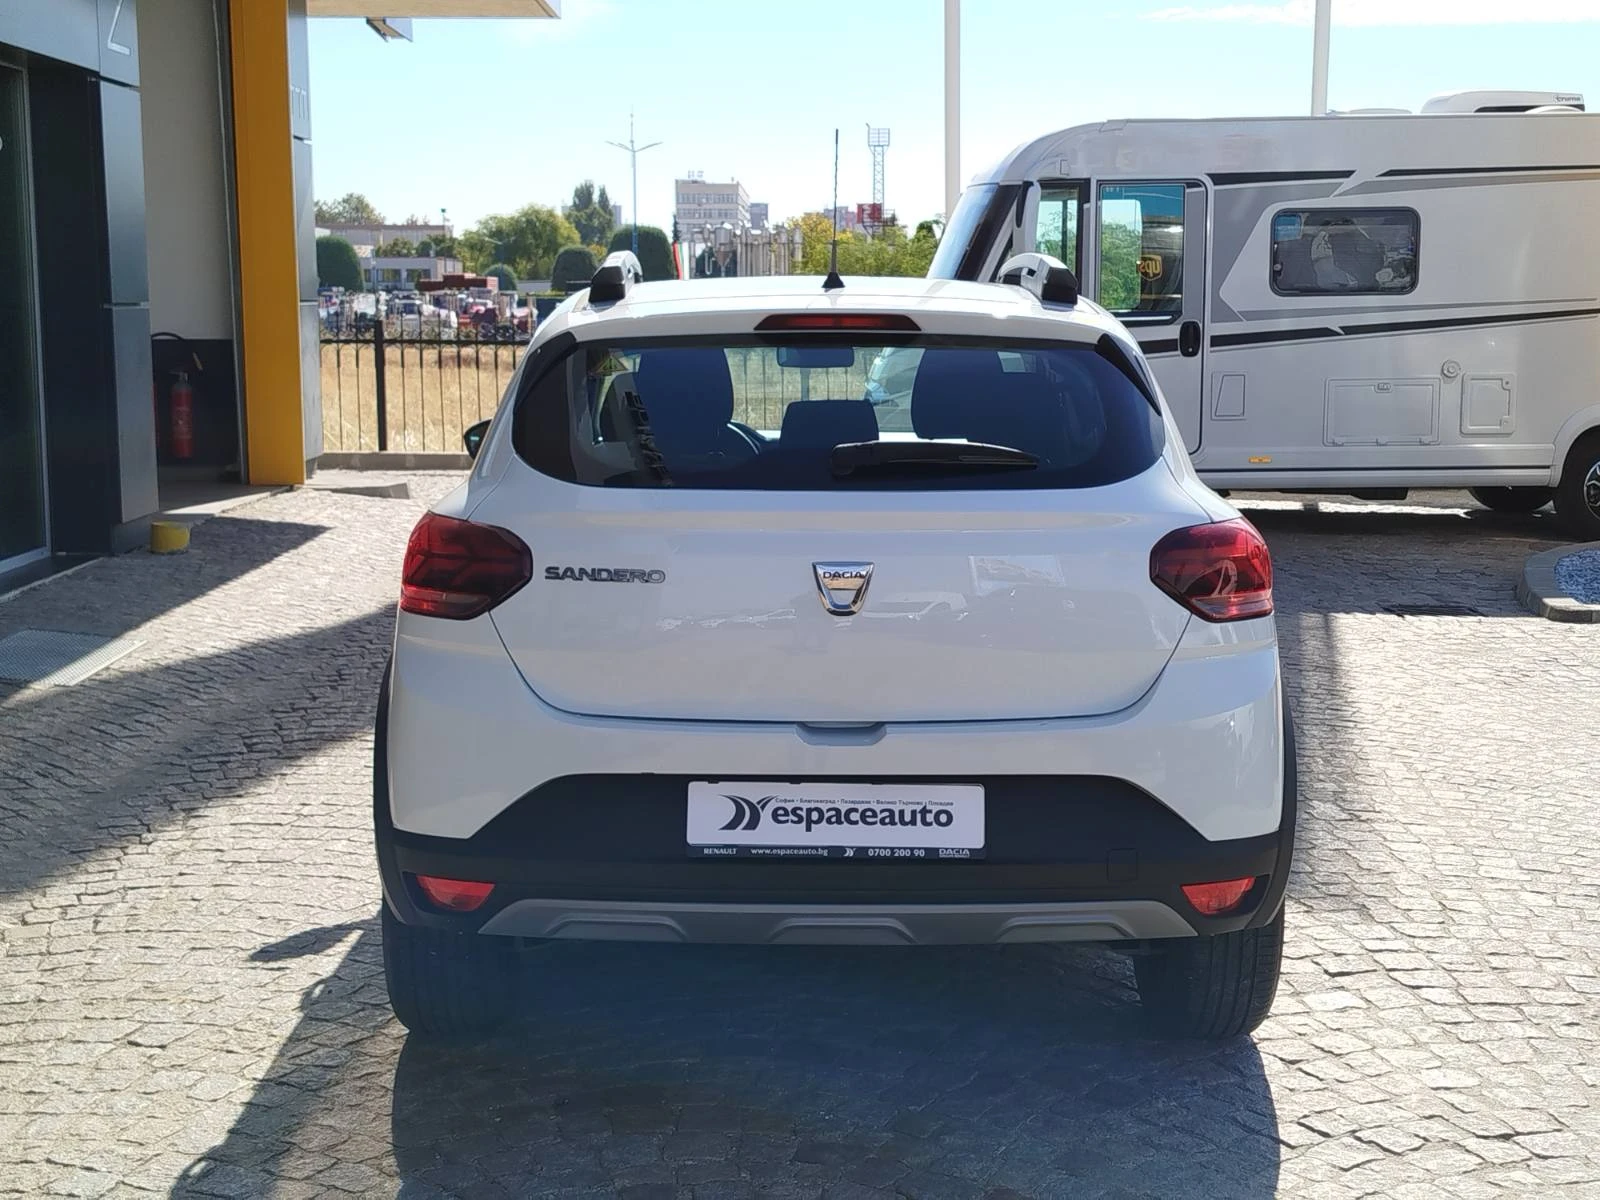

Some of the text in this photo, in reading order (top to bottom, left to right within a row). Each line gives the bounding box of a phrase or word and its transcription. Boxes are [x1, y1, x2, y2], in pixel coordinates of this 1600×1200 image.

[544, 566, 666, 583] SANDERO
[823, 571, 866, 579] DACIA
[771, 804, 954, 832] espaceauto
[750, 847, 829, 857] www.espaceauto.bg
[868, 848, 926, 857] 0700 200 90
